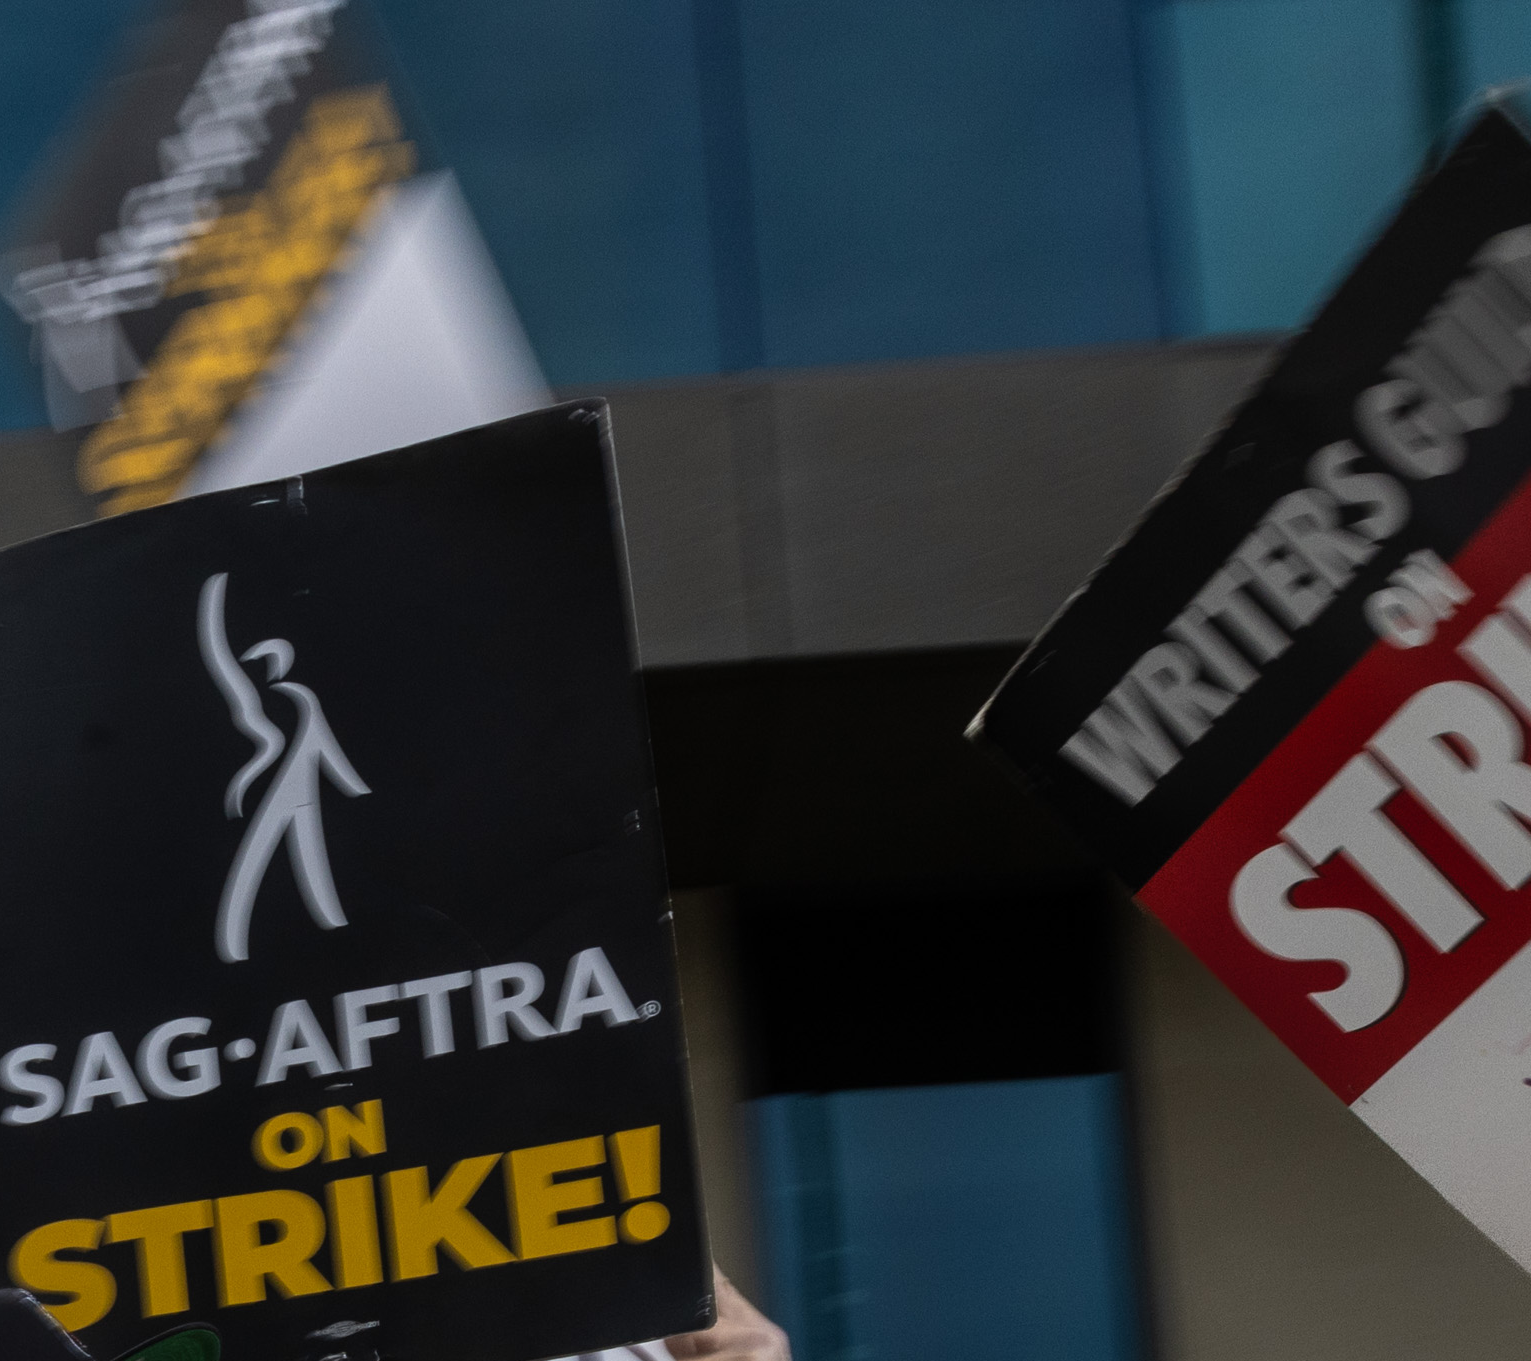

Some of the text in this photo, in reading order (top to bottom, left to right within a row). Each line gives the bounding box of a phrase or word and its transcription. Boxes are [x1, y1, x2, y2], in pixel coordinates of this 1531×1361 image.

[1057, 438, 1412, 807] WRITERS
[1363, 548, 1474, 650] ON
[251, 1098, 388, 1171] ON
[6, 1124, 671, 1334] STRIKE!
